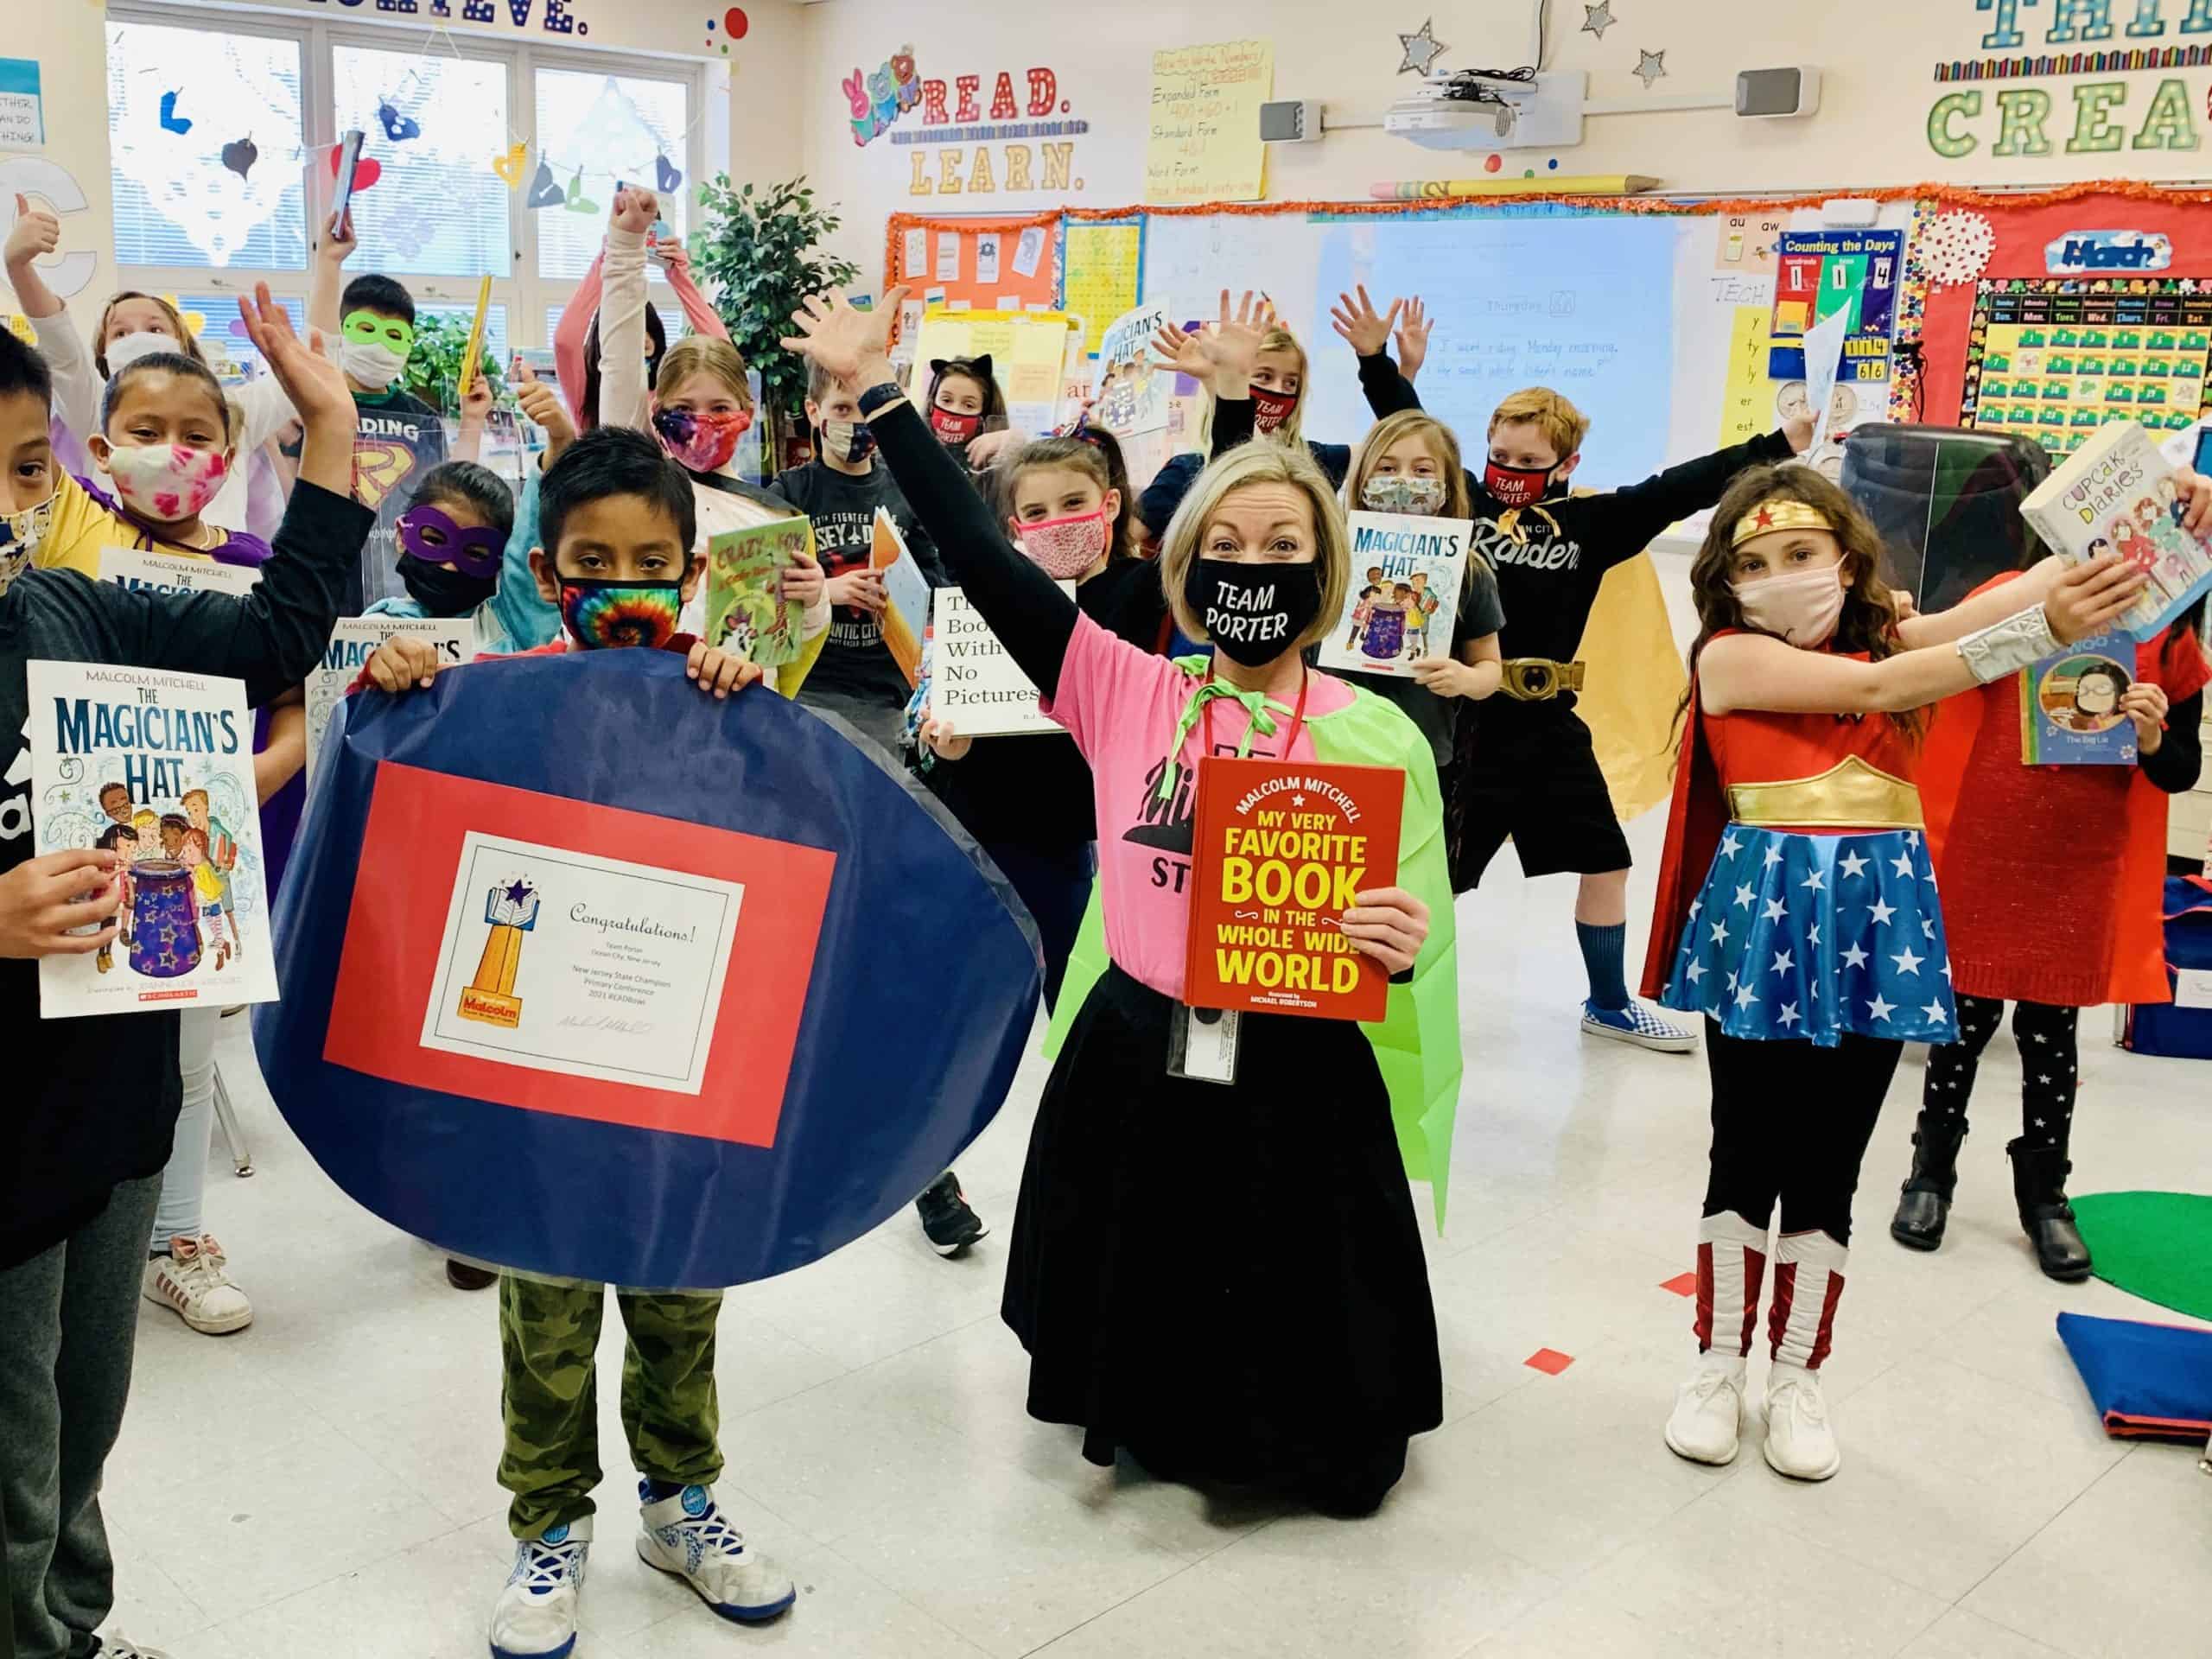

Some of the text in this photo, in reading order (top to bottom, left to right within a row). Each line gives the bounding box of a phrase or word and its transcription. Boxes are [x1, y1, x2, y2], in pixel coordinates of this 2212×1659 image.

[923, 67, 1071, 124] READ.
[1928, 79, 2200, 158] CREA
[909, 142, 1084, 195] LEARN.
[1729, 218, 1745, 228] au
[1761, 221, 1781, 232] aw
[1785, 238, 1895, 254] Counting the Days
[1256, 399, 1284, 414] TEAM
[940, 417, 963, 430] TEAM
[1495, 477, 1525, 492] TEAM
[1493, 491, 1532, 504] ORTER
[815, 524, 846, 553] SEY
[1353, 526, 1459, 557] MAGICIAN'S
[143, 559, 188, 572] MALCOLM
[1382, 556, 1418, 578] HAT
[175, 573, 192, 587] THE
[1217, 580, 1275, 612] TEAM
[946, 618, 990, 634] Boo
[1205, 607, 1288, 643] PORTER
[945, 639, 1003, 657] With
[86, 670, 208, 691] MALCOLM MITCHELL
[944, 664, 978, 682] No
[137, 686, 159, 704] THE
[944, 687, 1039, 706] Pictures
[54, 696, 238, 754] MAGICIAN'S
[124, 753, 184, 804] HAT
[1235, 776, 1300, 816] MALCOLM
[1303, 777, 1362, 823] MITCHELL
[1257, 810, 1338, 831] MY VERY
[1224, 827, 1368, 864] FAVORITE
[1221, 855, 1368, 911] BOOK
[569, 902, 696, 943] Congratulations!
[1263, 907, 1317, 927] IN THE
[1217, 924, 1294, 950] WHOLE
[572, 964, 589, 975] New
[1216, 948, 1360, 995] WORLD
[462, 995, 517, 1019] Malcolm
[1250, 995, 1318, 1008] MICHAEL ROBERTSON
